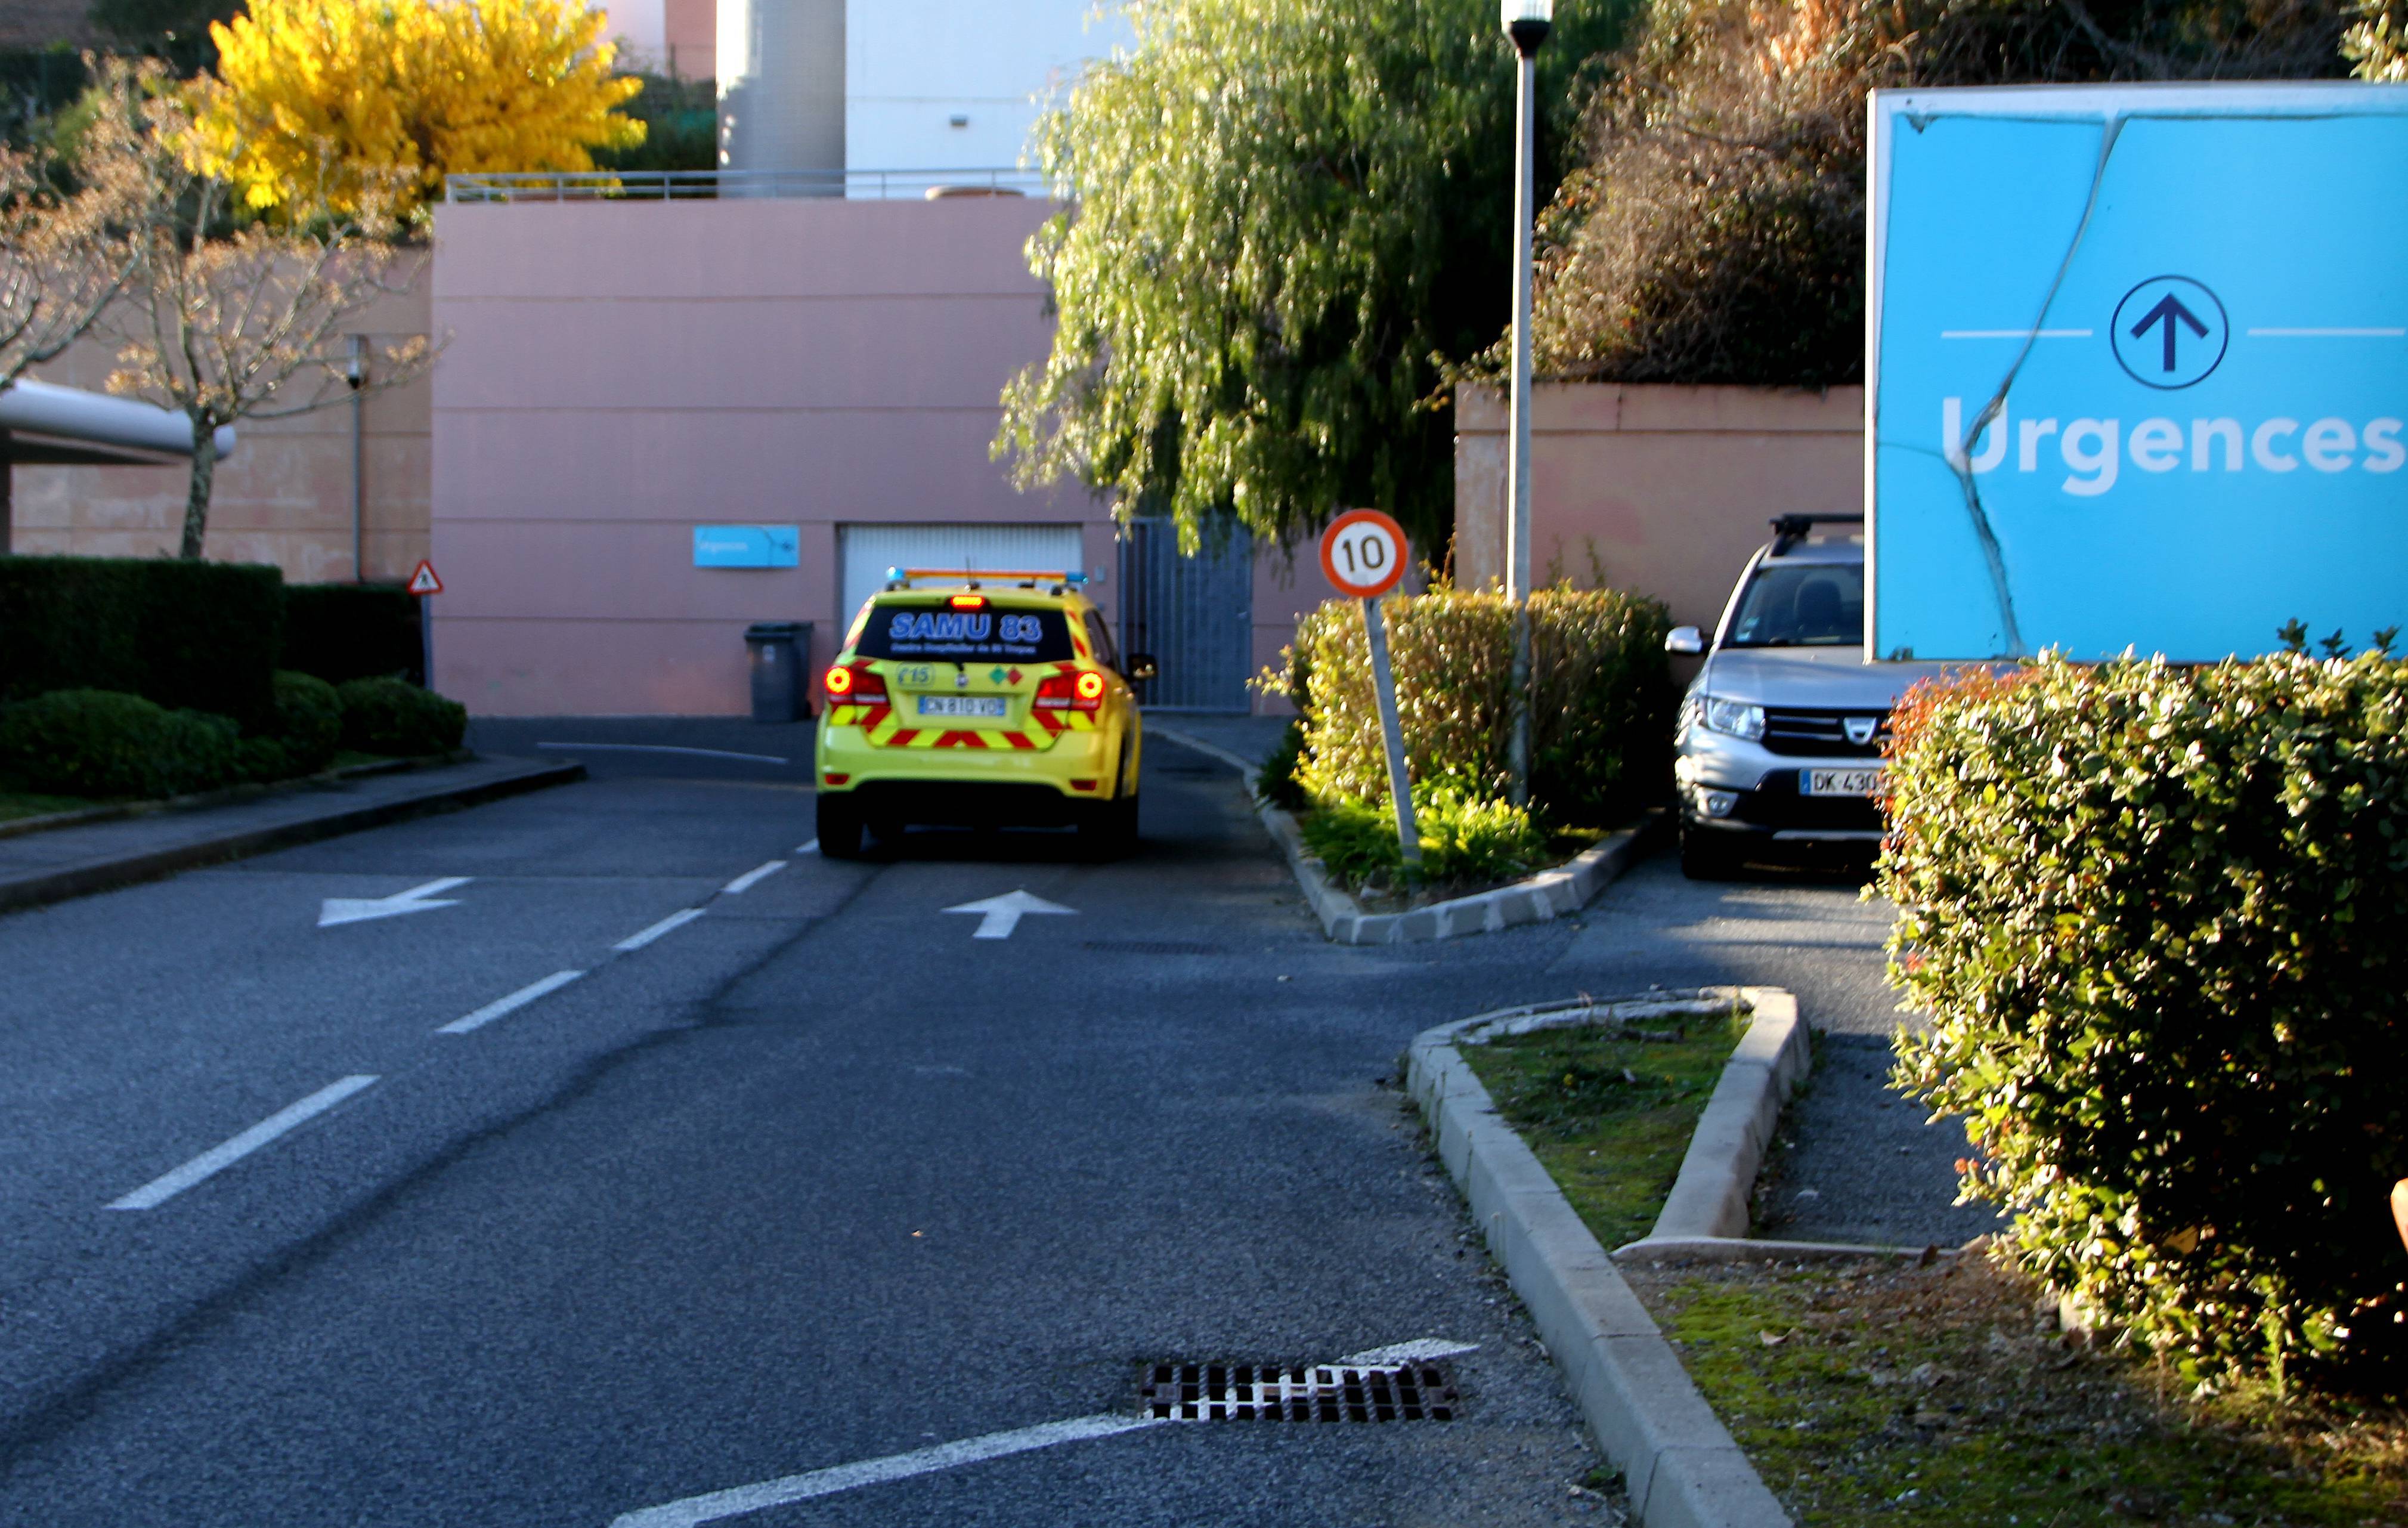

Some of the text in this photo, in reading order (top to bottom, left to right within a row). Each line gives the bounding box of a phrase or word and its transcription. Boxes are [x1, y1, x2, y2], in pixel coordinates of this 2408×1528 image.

[1942, 396, 2406, 497] Urgences
[1342, 535, 1385, 573] 10
[889, 612, 1043, 643] SAMU 83
